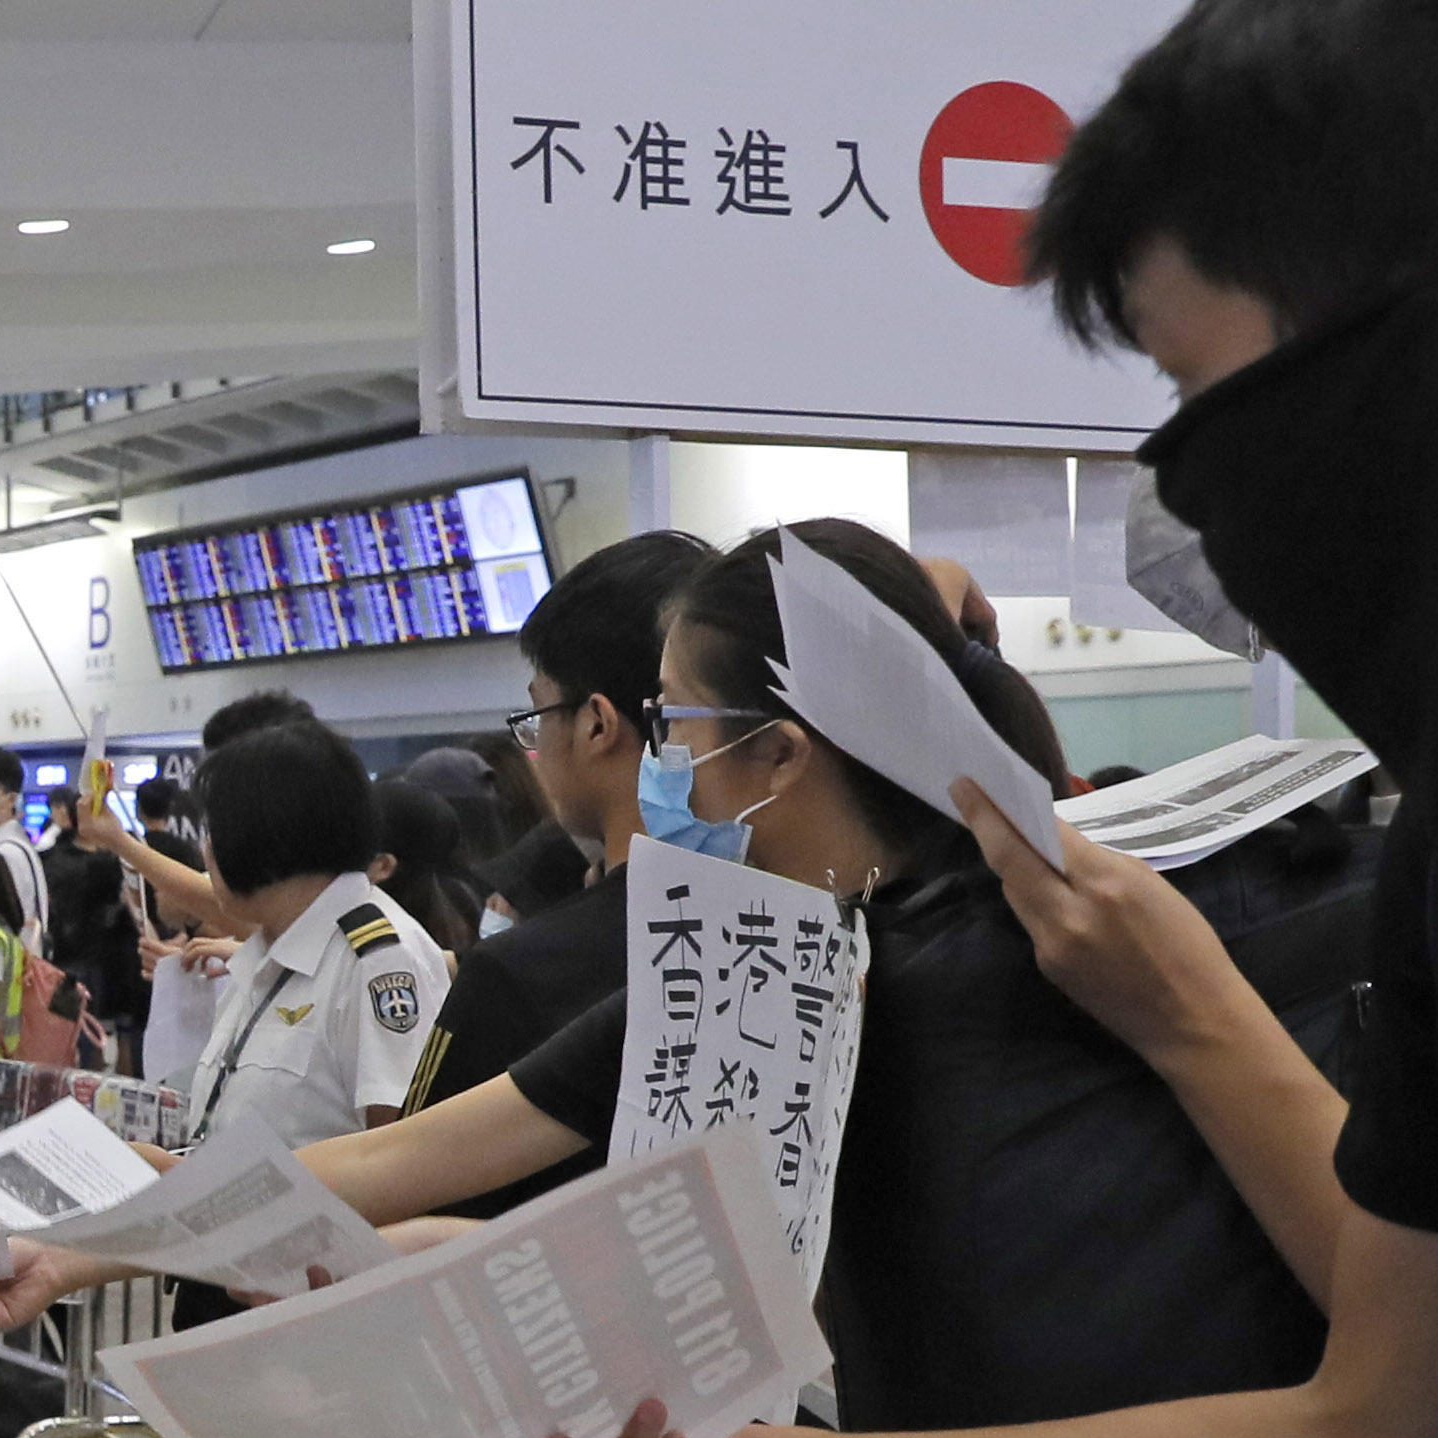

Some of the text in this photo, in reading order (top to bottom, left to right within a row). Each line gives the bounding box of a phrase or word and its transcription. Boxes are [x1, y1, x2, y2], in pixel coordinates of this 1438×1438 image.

[510, 115, 892, 224] 不准進入
[89, 576, 112, 650] B
